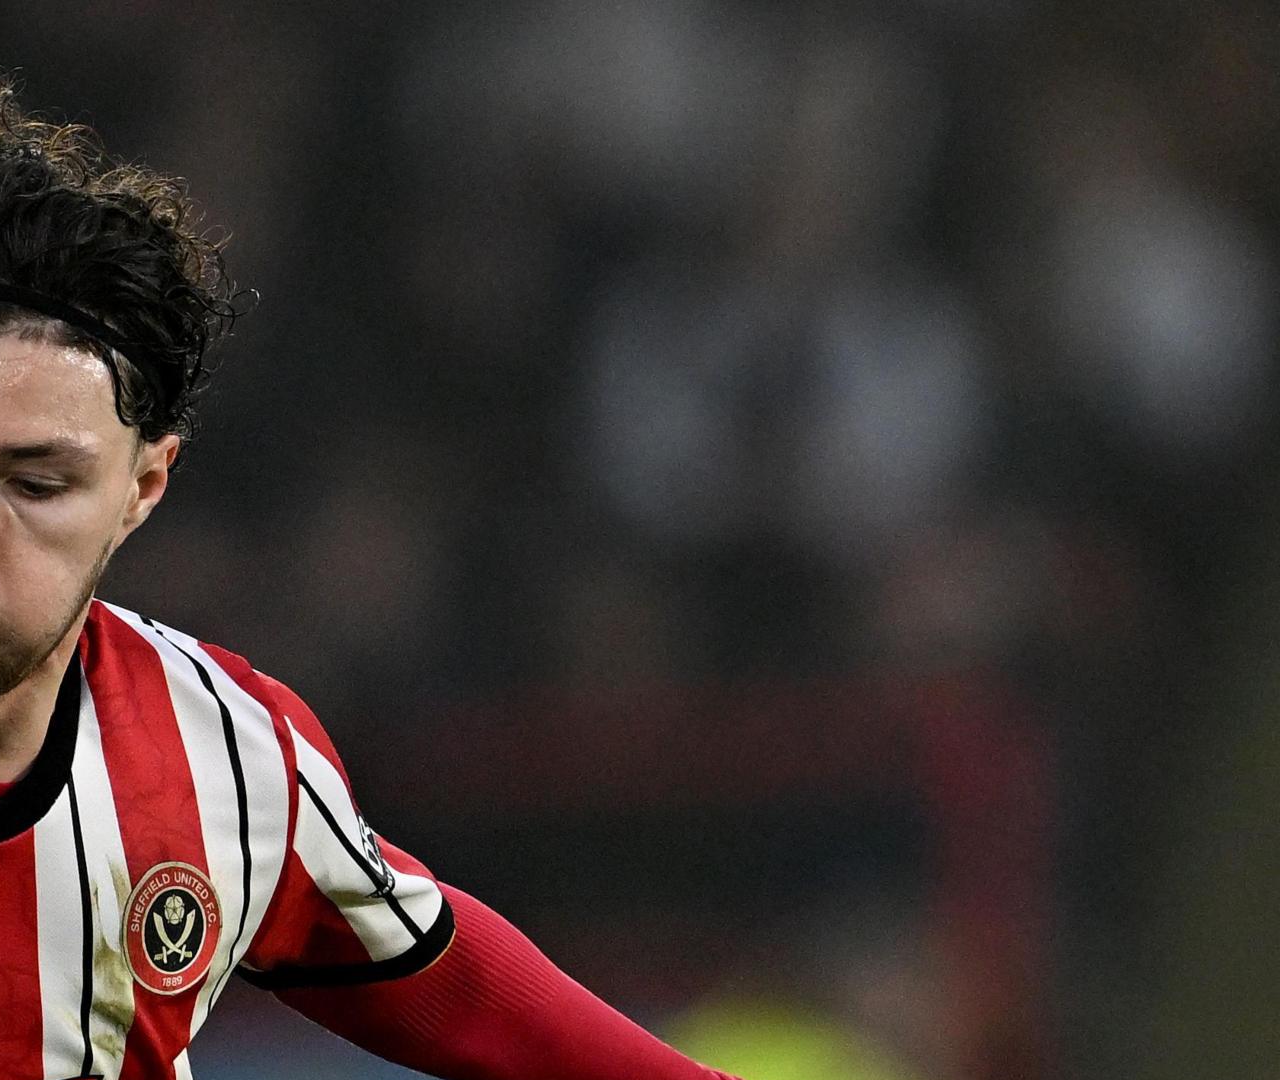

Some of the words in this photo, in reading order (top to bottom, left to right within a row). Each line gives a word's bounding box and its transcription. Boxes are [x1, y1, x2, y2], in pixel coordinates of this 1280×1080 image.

[131, 873, 171, 933] SHEFFIELD
[173, 871, 209, 900] UNITED
[206, 902, 217, 927] F.C.
[162, 975, 184, 988] 1889
